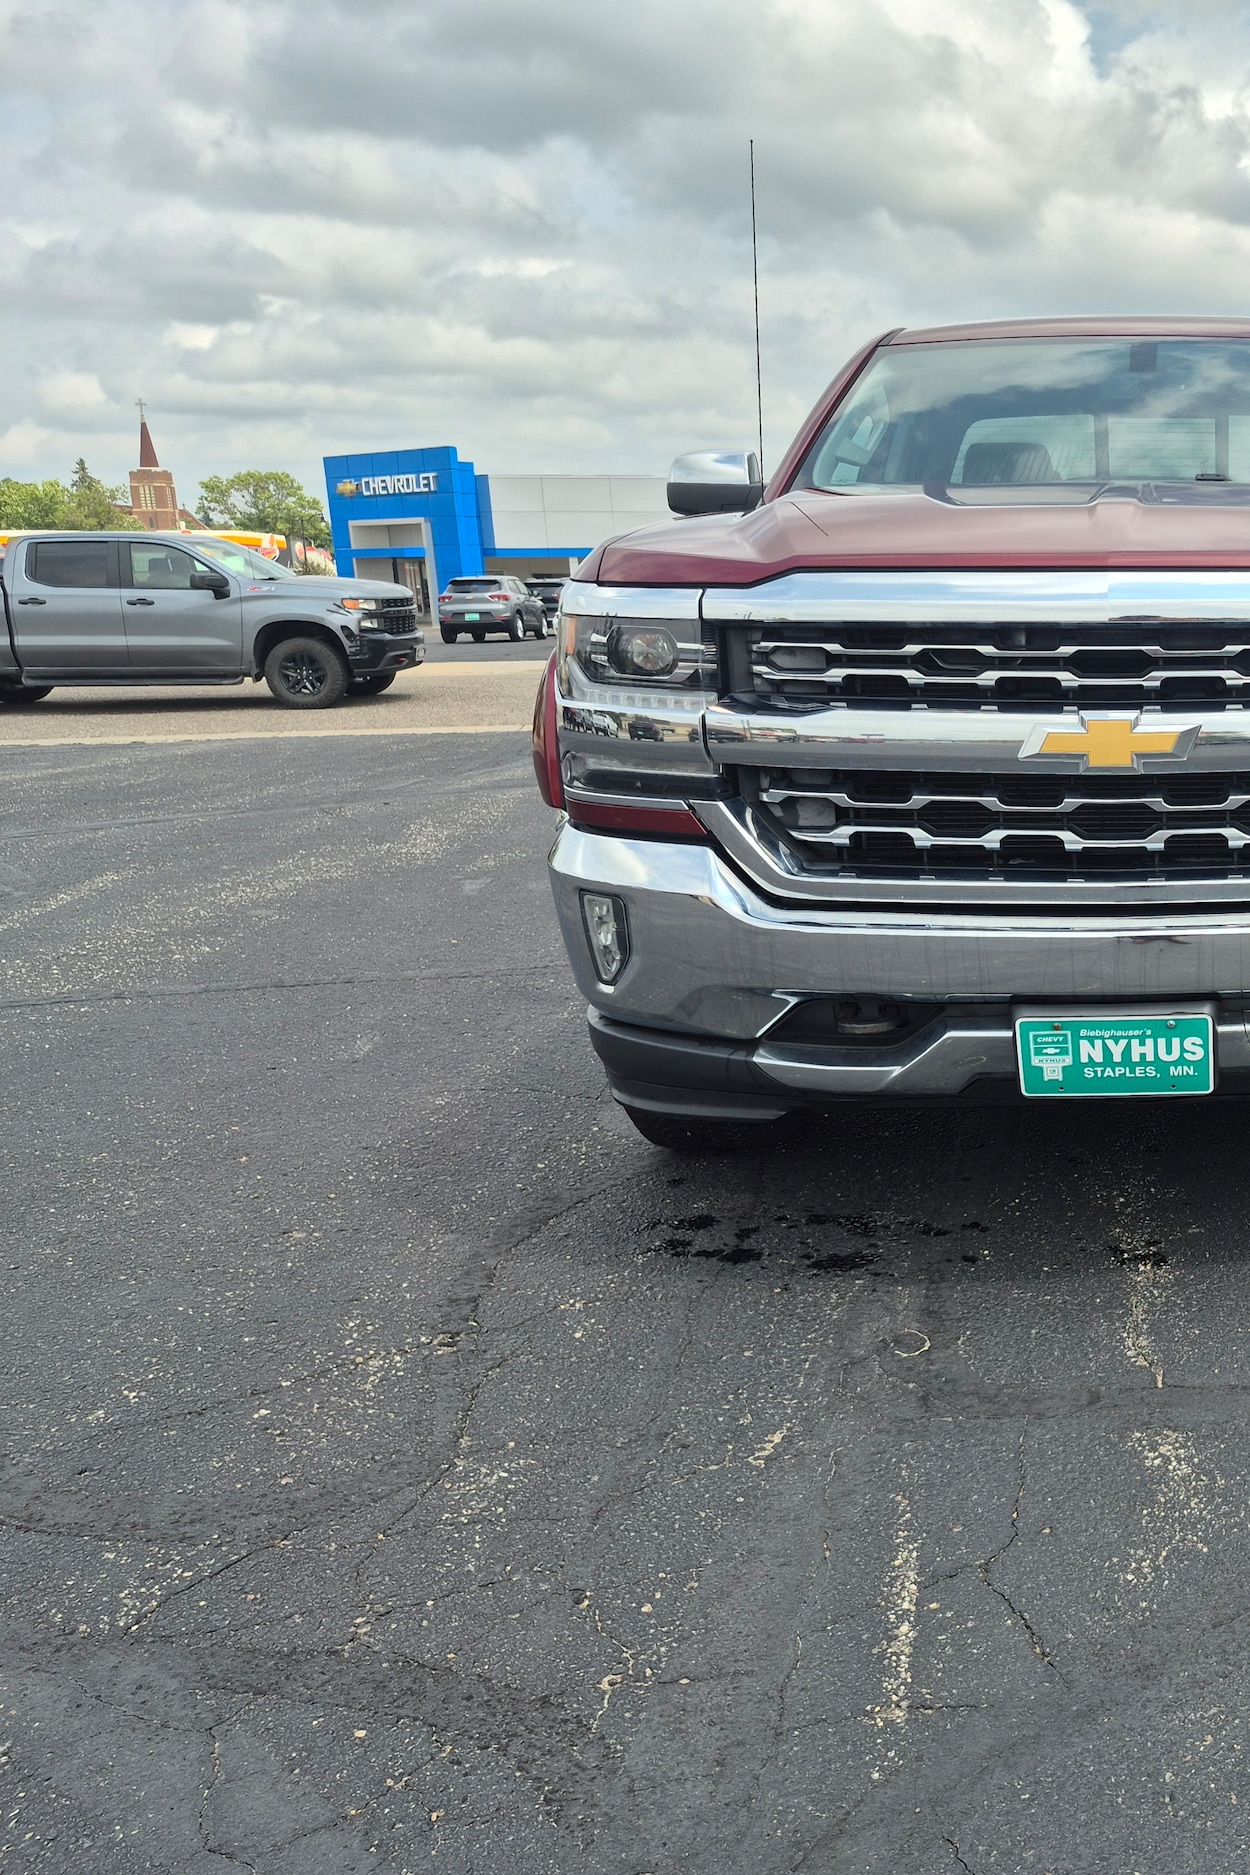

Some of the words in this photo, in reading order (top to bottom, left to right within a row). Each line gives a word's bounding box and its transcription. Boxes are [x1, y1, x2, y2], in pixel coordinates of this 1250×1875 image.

[361, 472, 438, 496] CHEVROLET
[1079, 1028, 1152, 1038] Biebighauser's
[1079, 1036, 1205, 1063] NYHUS
[1083, 1066, 1161, 1078] STAPLES,
[1169, 1065, 1199, 1076] MN.
